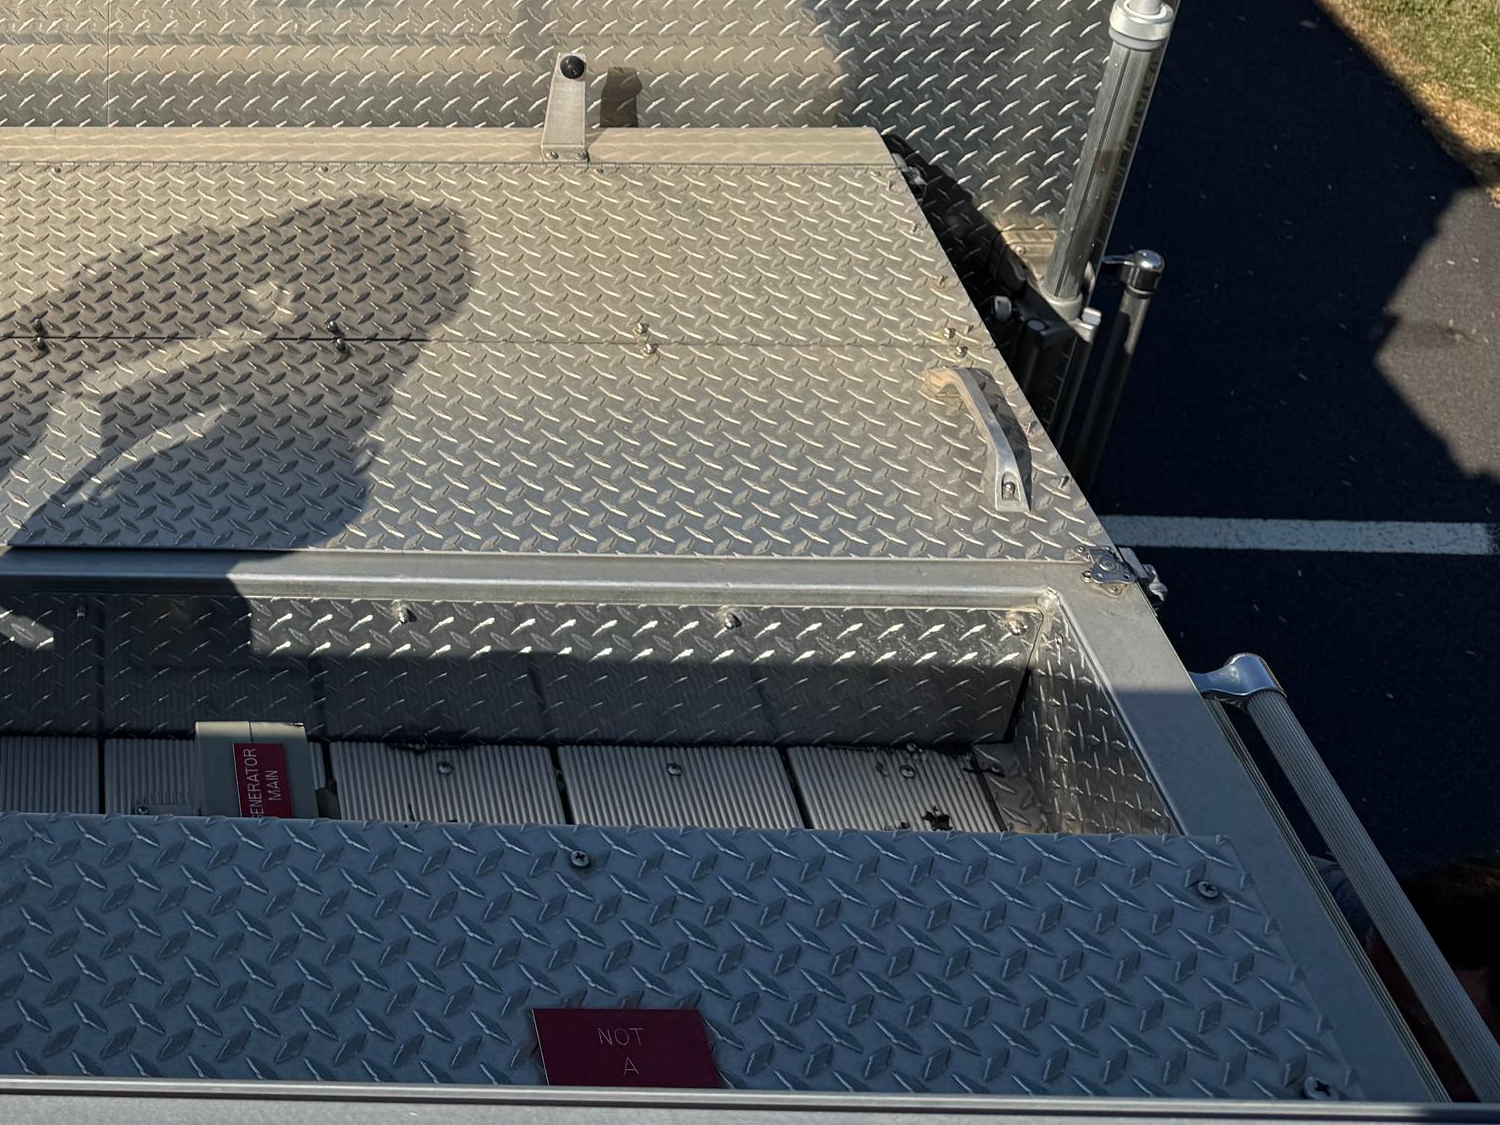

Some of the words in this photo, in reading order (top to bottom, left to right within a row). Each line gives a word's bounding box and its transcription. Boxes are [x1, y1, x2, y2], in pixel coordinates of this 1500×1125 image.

[243, 748, 264, 818] ENERATOR
[266, 770, 282, 801] MAIN
[597, 1027, 644, 1045] NOT
[623, 1056, 640, 1075] A
